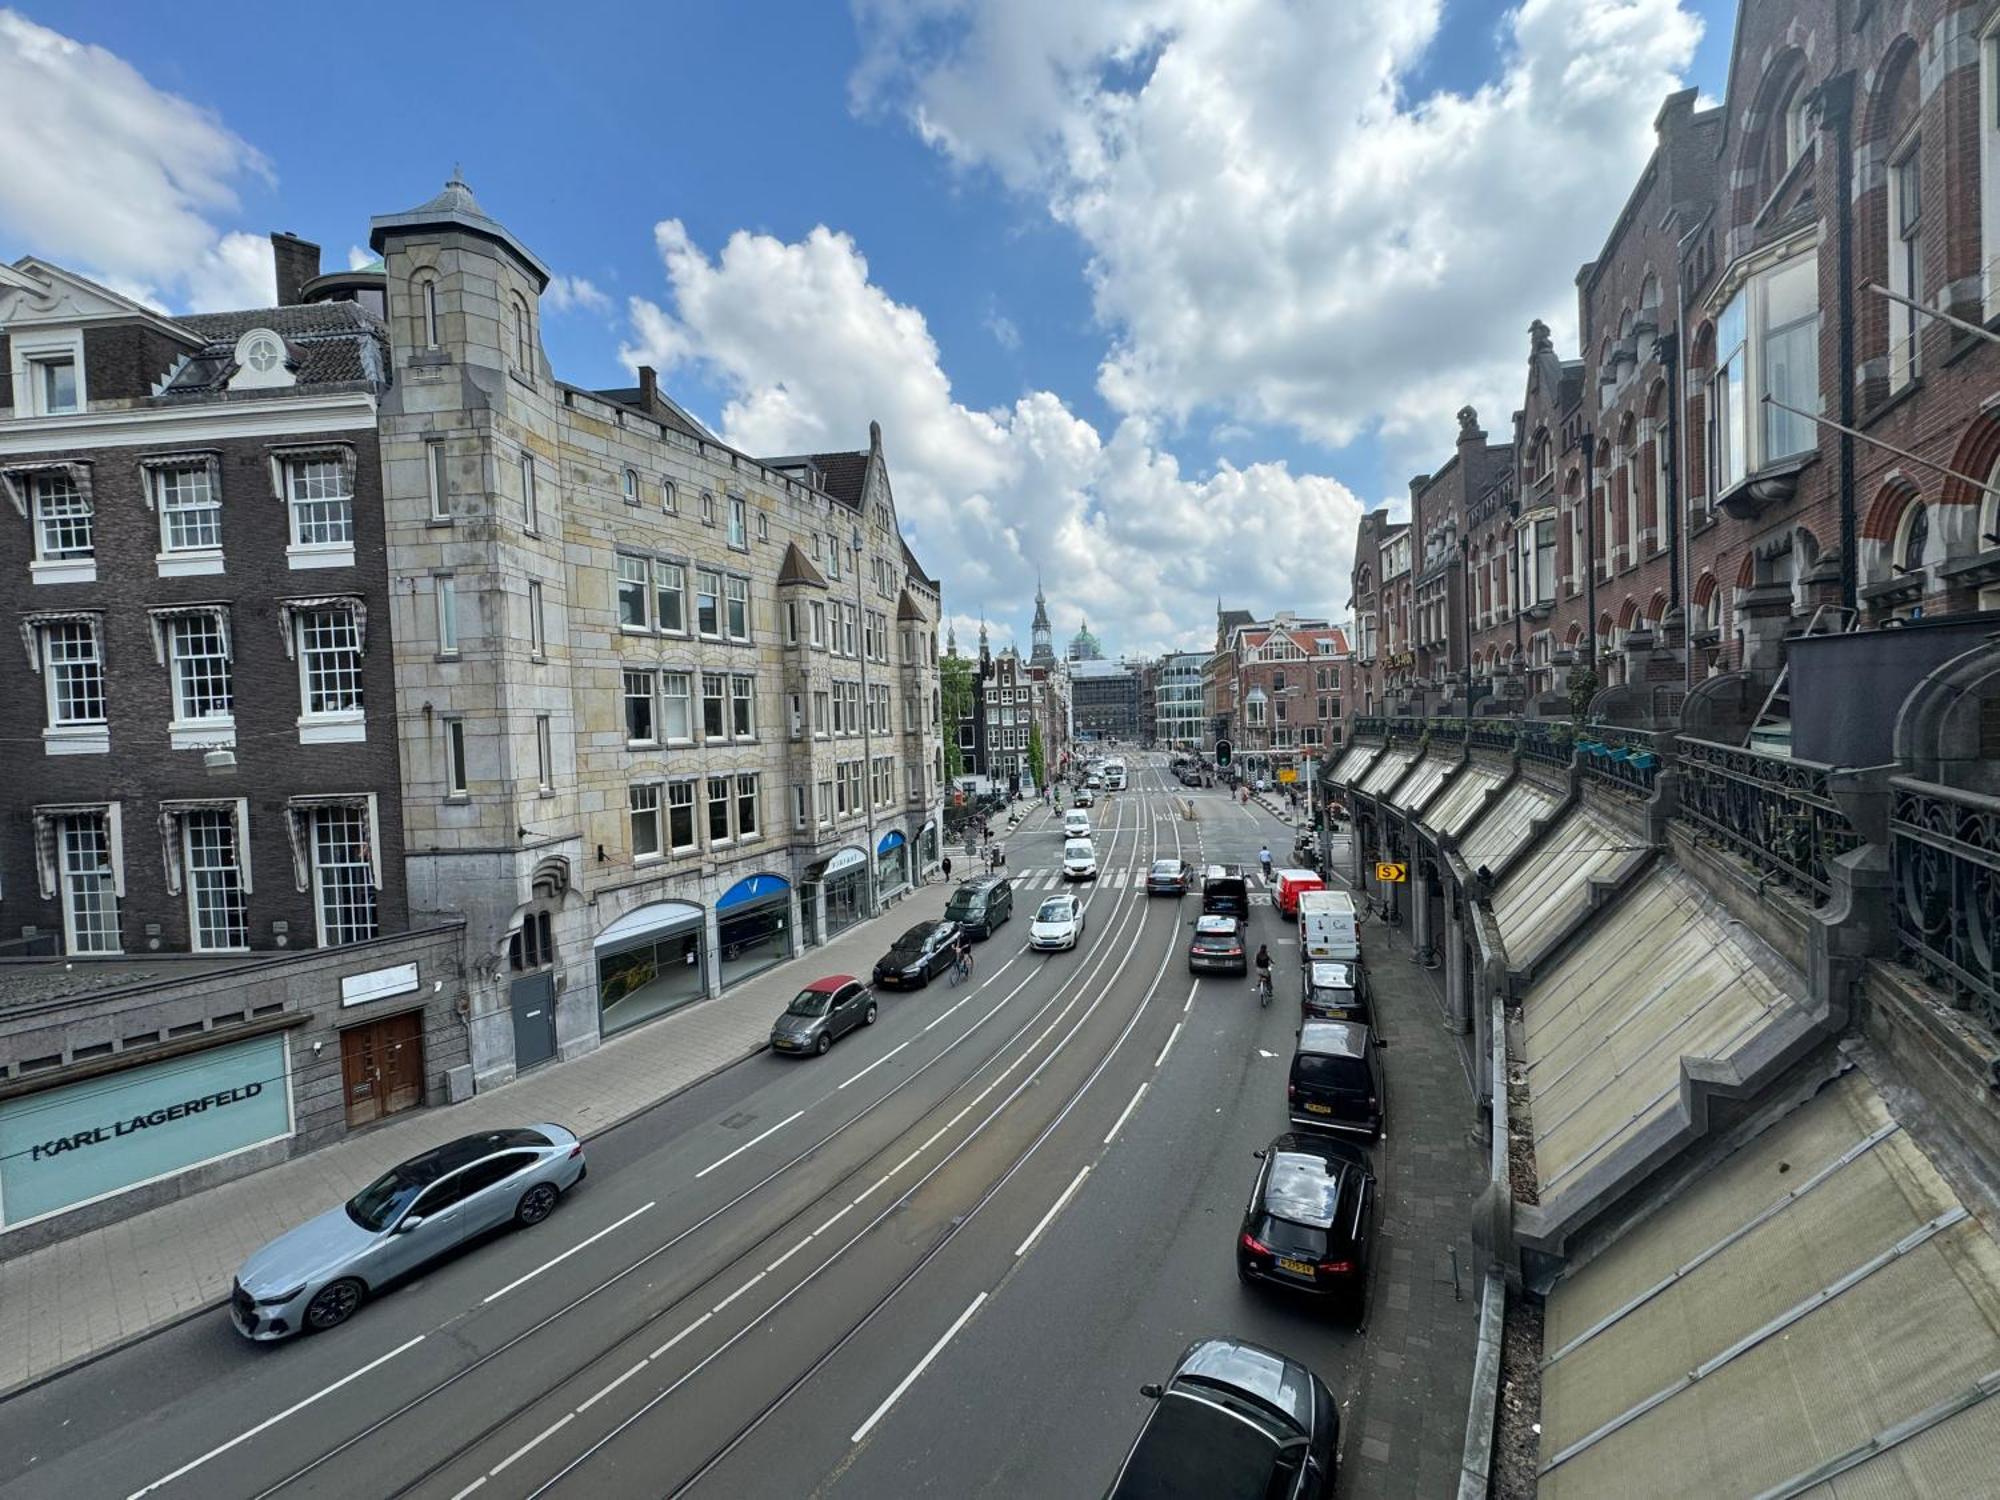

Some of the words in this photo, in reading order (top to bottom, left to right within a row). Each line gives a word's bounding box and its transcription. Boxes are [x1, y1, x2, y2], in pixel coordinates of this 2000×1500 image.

[1382, 867, 1391, 877] S
[32, 1127, 111, 1161] KARL
[115, 1082, 262, 1137] LAGERFELD
